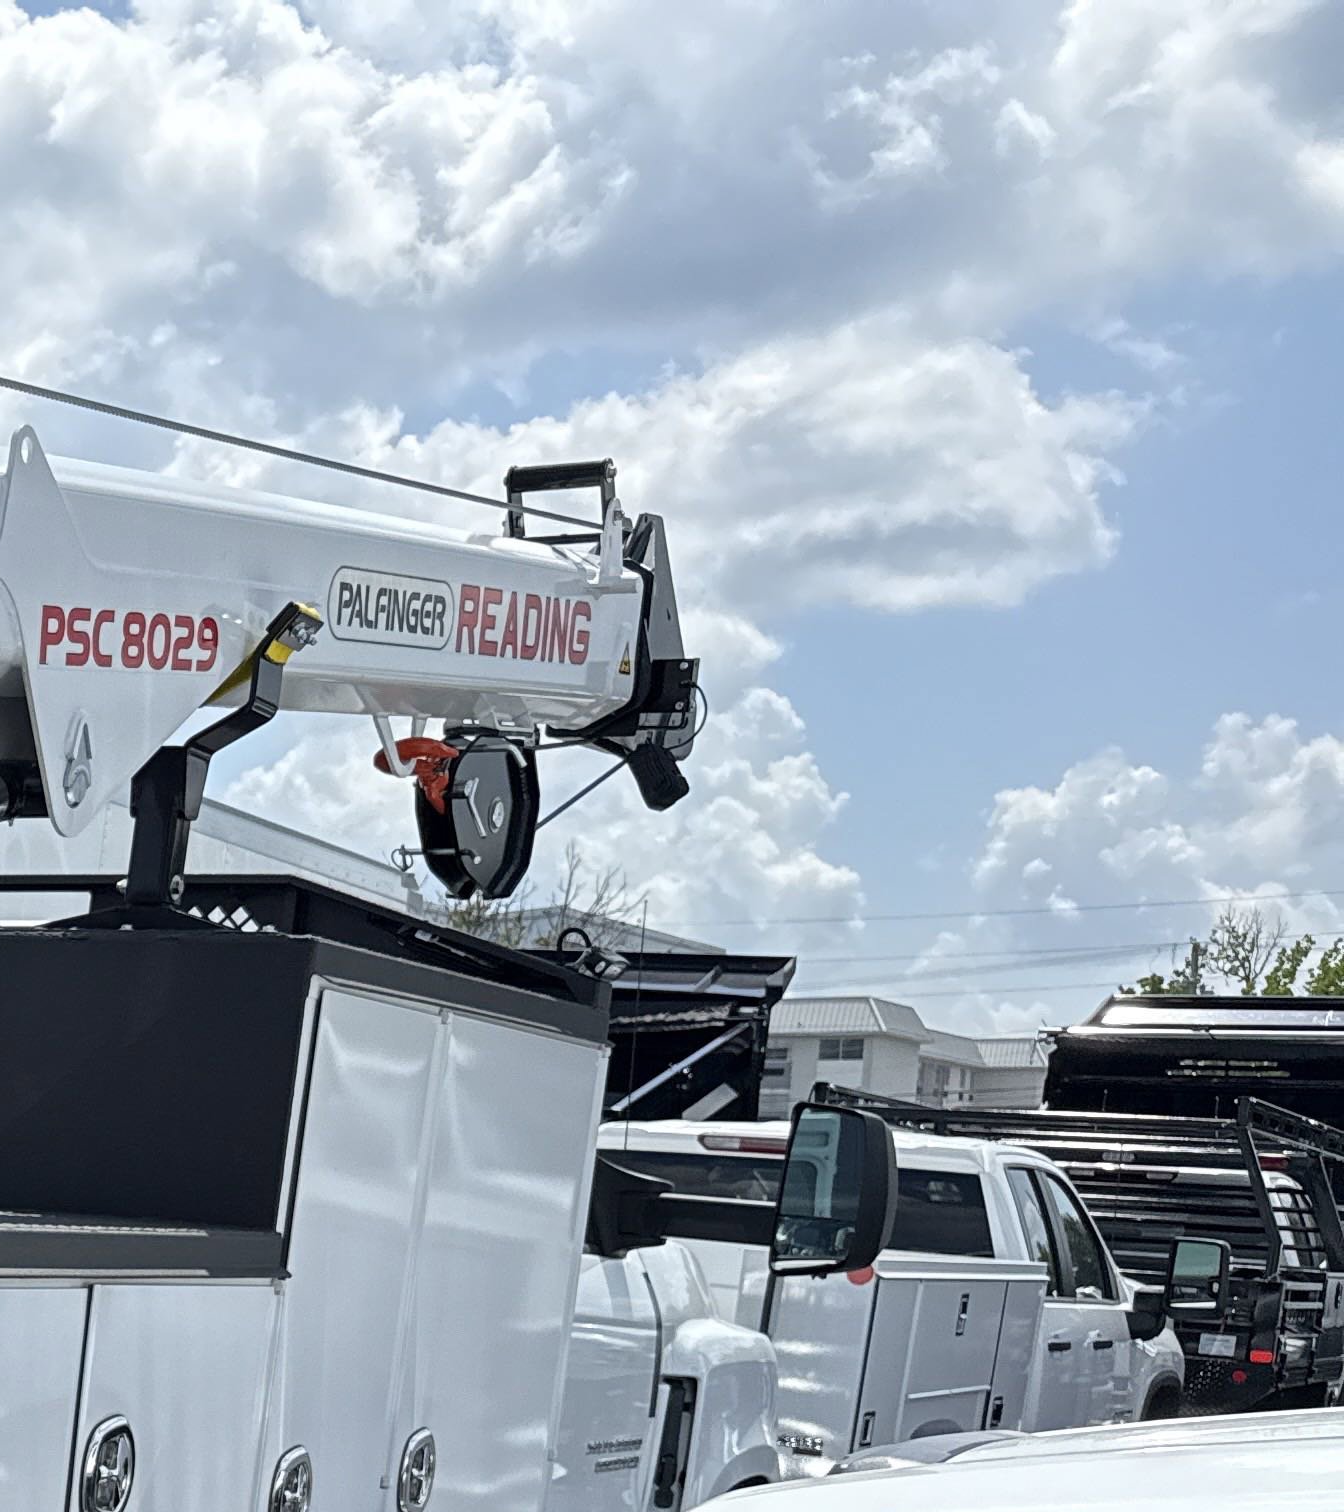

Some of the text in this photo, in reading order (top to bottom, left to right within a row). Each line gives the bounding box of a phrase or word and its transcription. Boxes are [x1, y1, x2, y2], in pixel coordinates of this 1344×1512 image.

[39, 604, 219, 672] PSC 8029
[336, 581, 592, 666] PALFINGER READING
